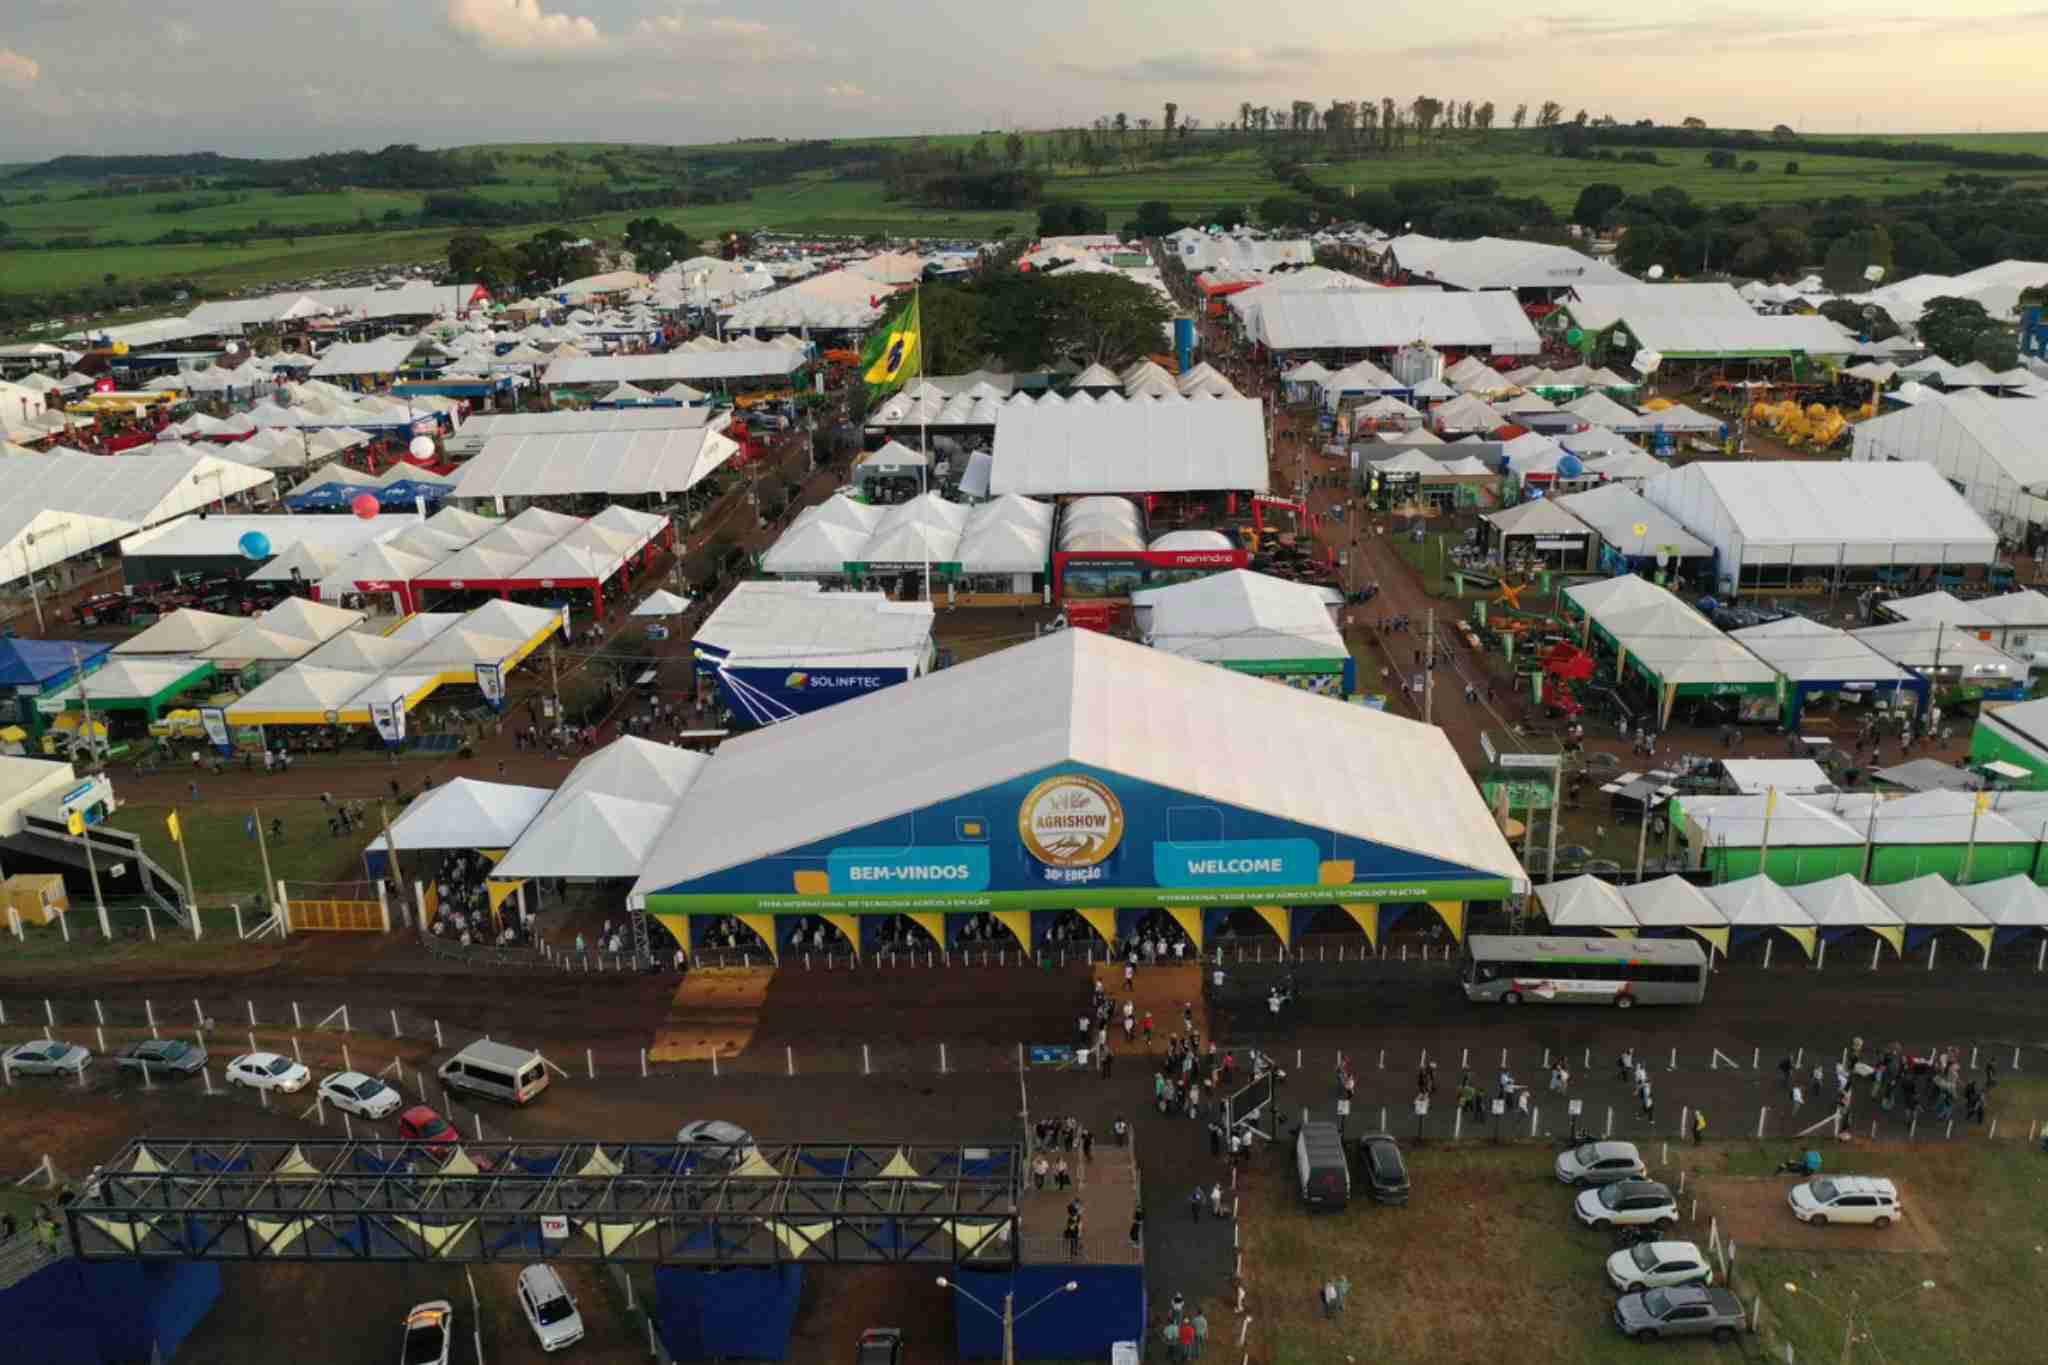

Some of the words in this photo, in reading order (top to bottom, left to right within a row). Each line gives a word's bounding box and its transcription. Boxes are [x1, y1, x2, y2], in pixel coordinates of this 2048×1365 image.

[1176, 553, 1233, 563] mahindra
[810, 676, 880, 687] SOLINFTEC
[1037, 815, 1106, 828] AGRISHOW
[850, 864, 969, 880] BEM-VINDOS
[1187, 858, 1283, 873] WELCOME
